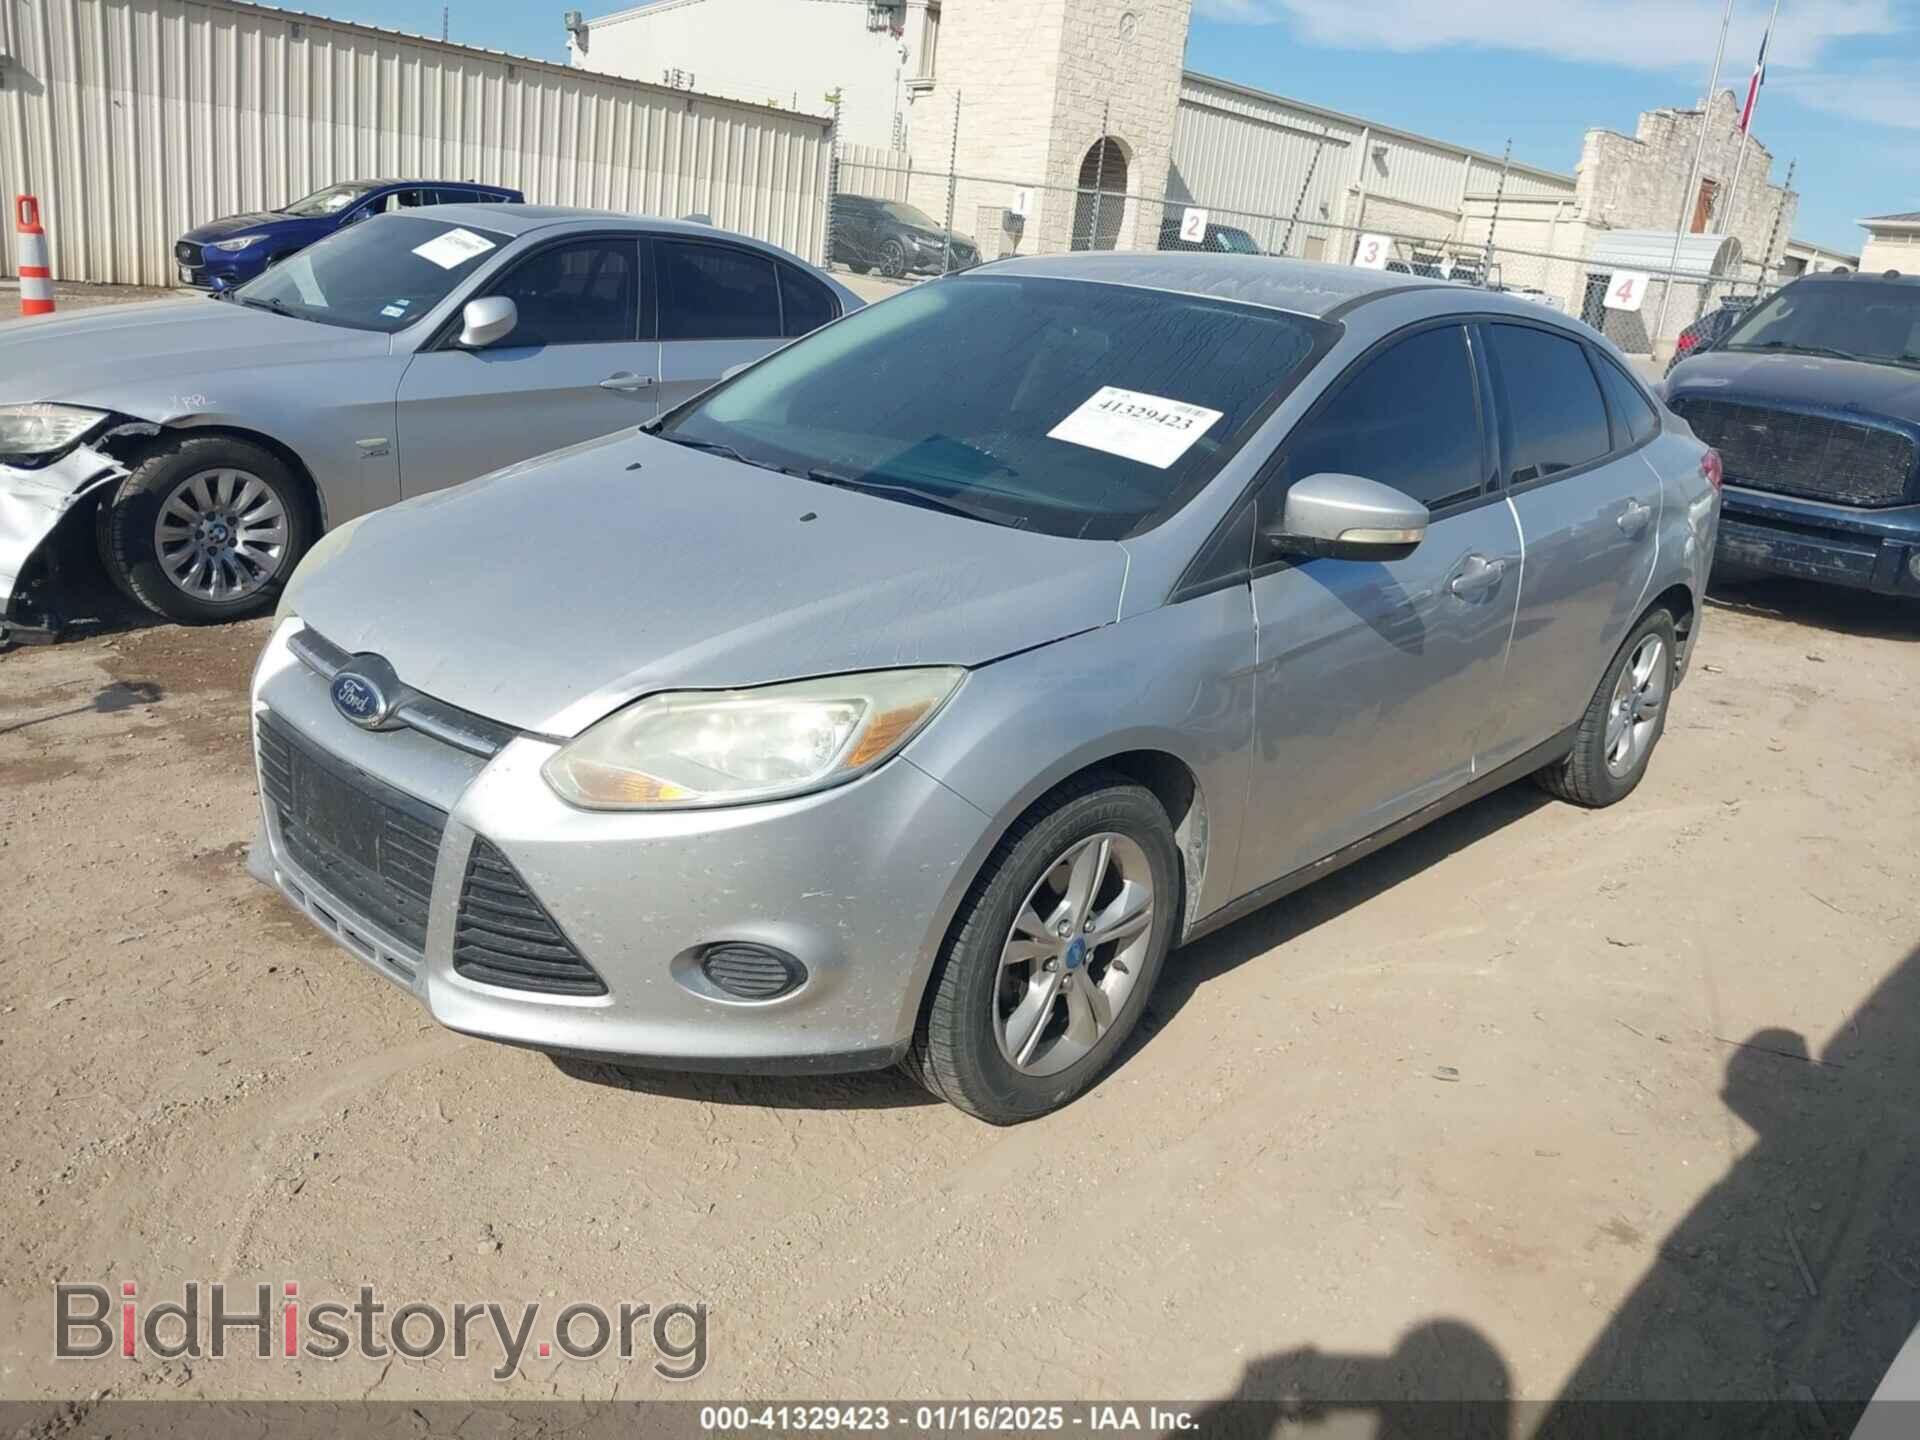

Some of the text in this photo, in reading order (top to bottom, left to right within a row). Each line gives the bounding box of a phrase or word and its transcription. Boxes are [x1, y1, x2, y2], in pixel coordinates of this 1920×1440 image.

[1019, 191, 1026, 210] 1
[1186, 216, 1200, 236] 2
[1364, 241, 1379, 264] 3
[1615, 278, 1634, 303] 4
[1098, 398, 1195, 431] 41329423
[338, 679, 369, 712] Ford
